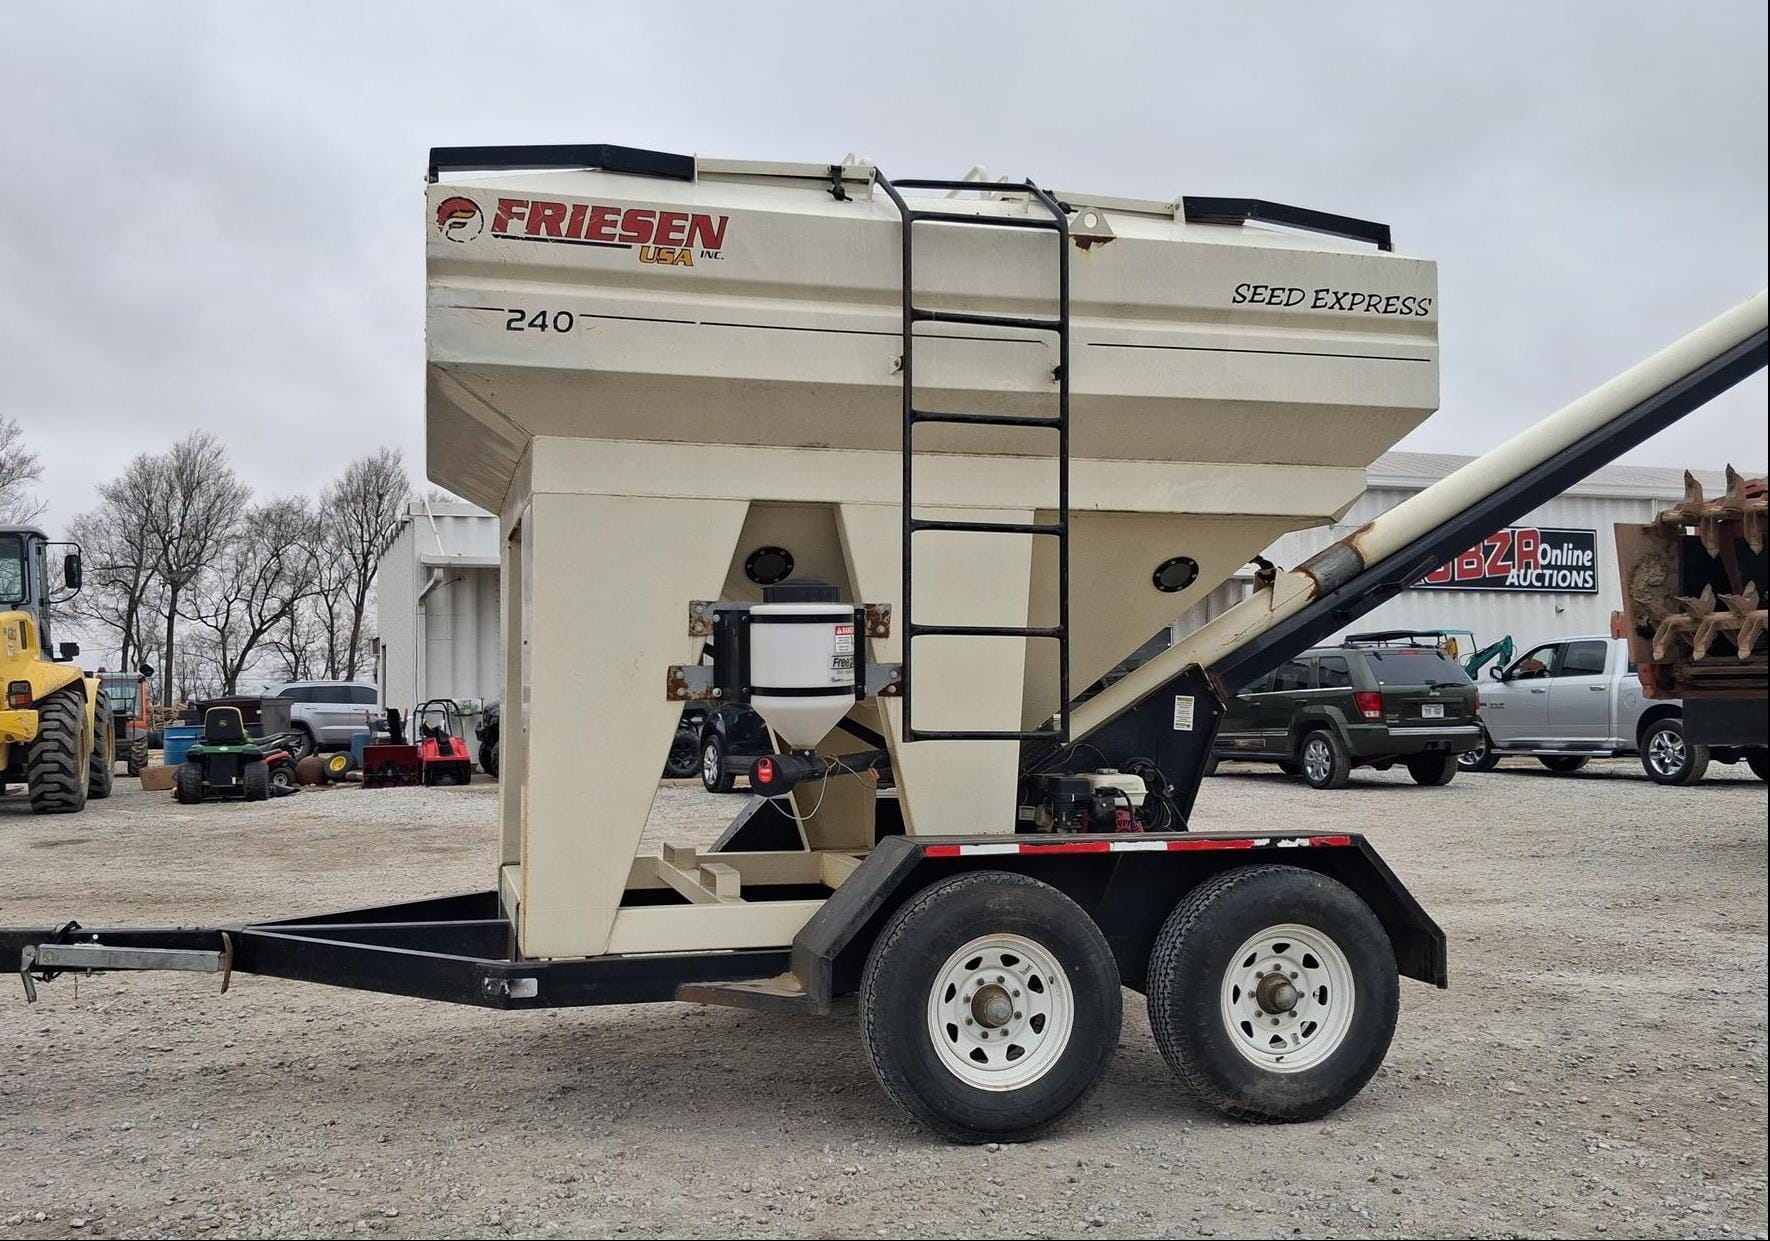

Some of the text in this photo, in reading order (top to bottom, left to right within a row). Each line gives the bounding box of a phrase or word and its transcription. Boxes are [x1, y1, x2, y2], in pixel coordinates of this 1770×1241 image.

[491, 198, 729, 250] FRIESEN
[639, 246, 725, 267] USA INC.
[1232, 283, 1433, 317] SEED EXPRESS
[505, 308, 575, 333] 240
[1414, 528, 1593, 585] BZA Online
[1505, 569, 1594, 589] AUCTIONS
